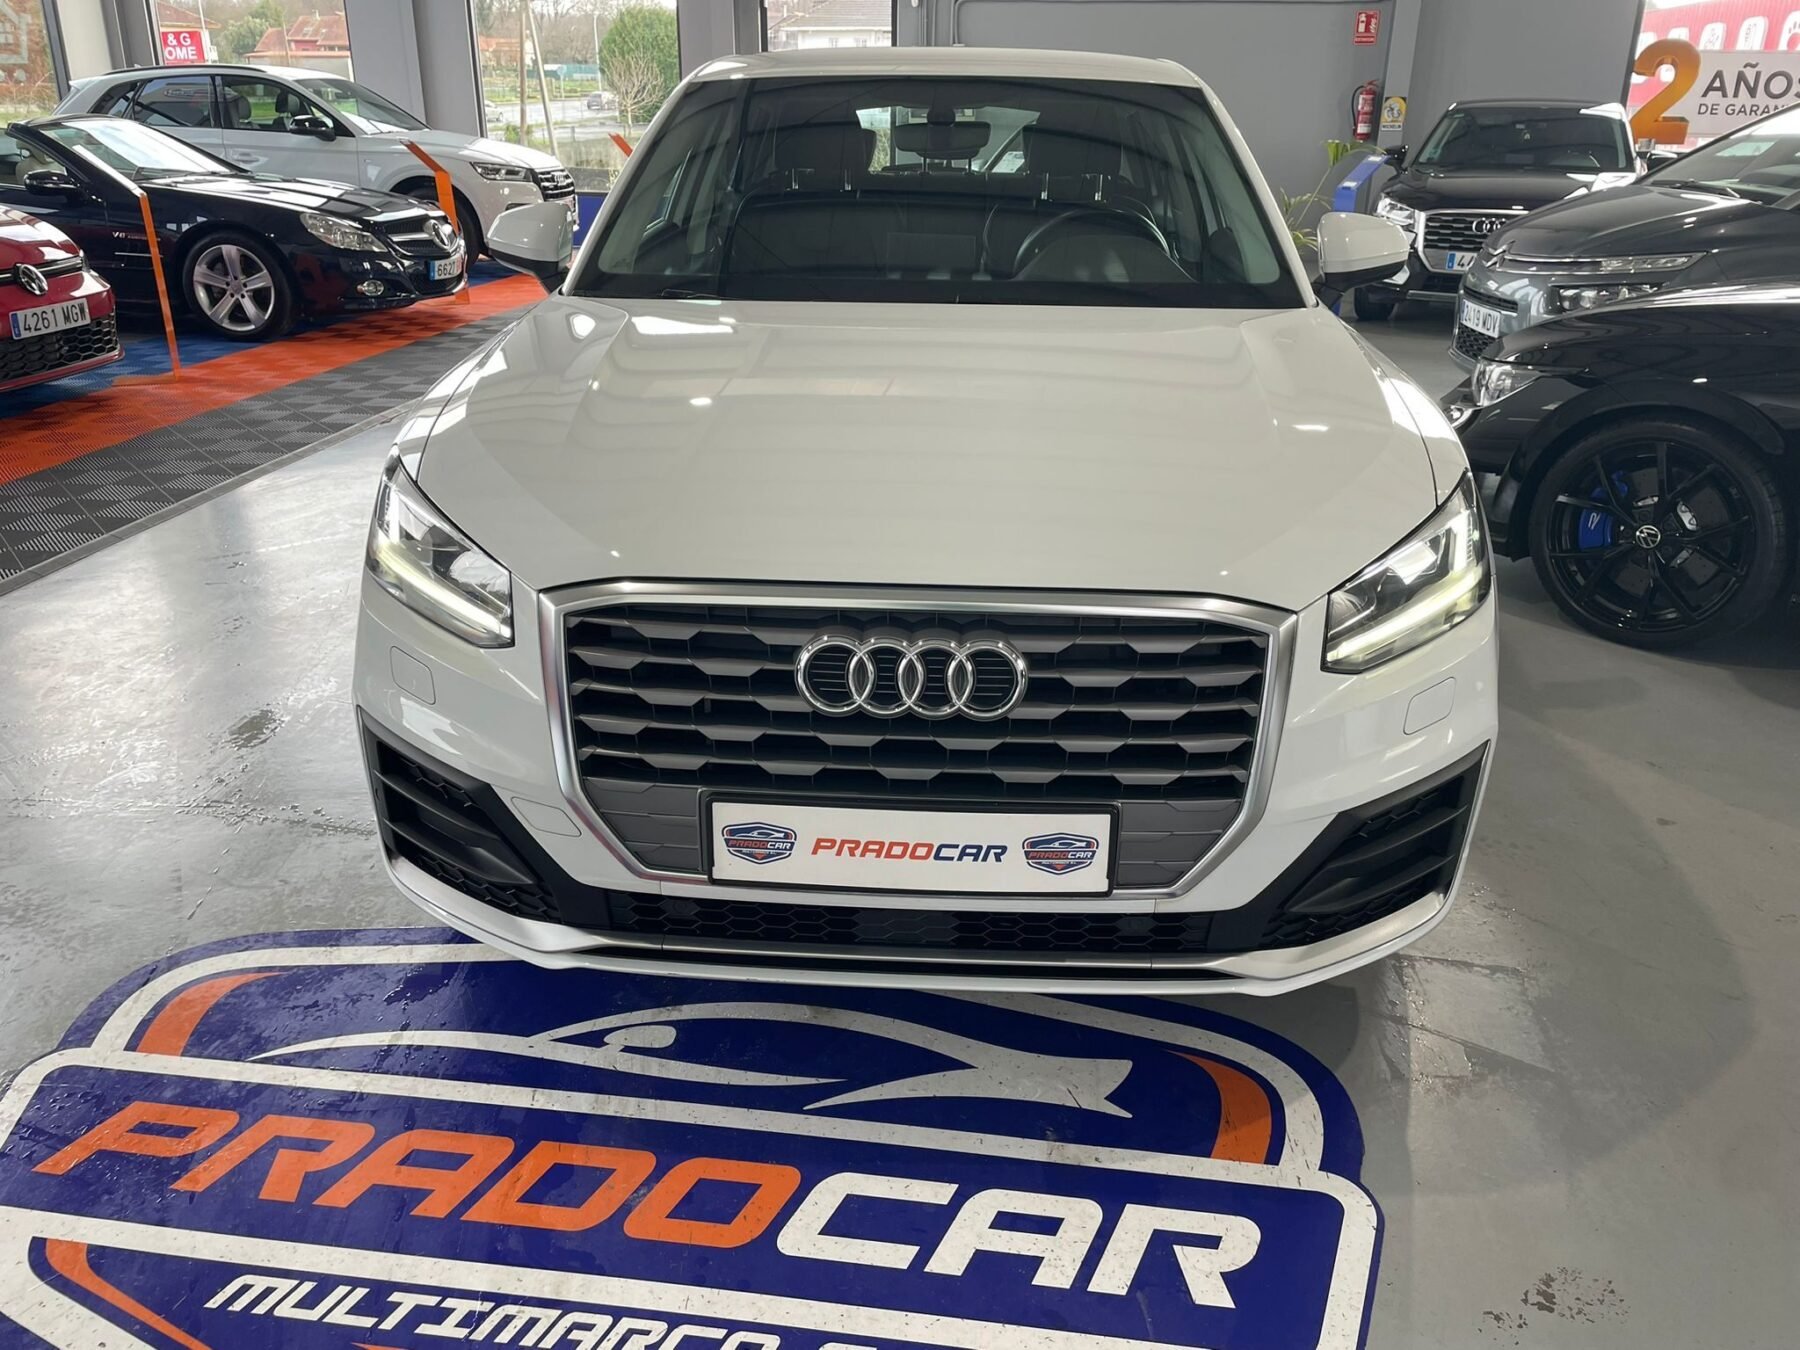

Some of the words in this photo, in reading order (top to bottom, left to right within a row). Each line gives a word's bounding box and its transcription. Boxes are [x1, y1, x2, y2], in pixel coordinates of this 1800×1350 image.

[167, 32, 178, 45] &
[180, 32, 191, 45] G
[1630, 38, 1702, 145] 2
[1697, 103, 1721, 115] DE
[437, 261, 456, 277] 6627
[23, 308, 59, 334] 4261
[61, 301, 88, 326] MGW
[728, 839, 792, 850] PRADOCAR
[811, 837, 1008, 863] PRADOCAR
[1029, 851, 1093, 859] PRADOCAR
[32, 1100, 1261, 1309] PRADOCAR
